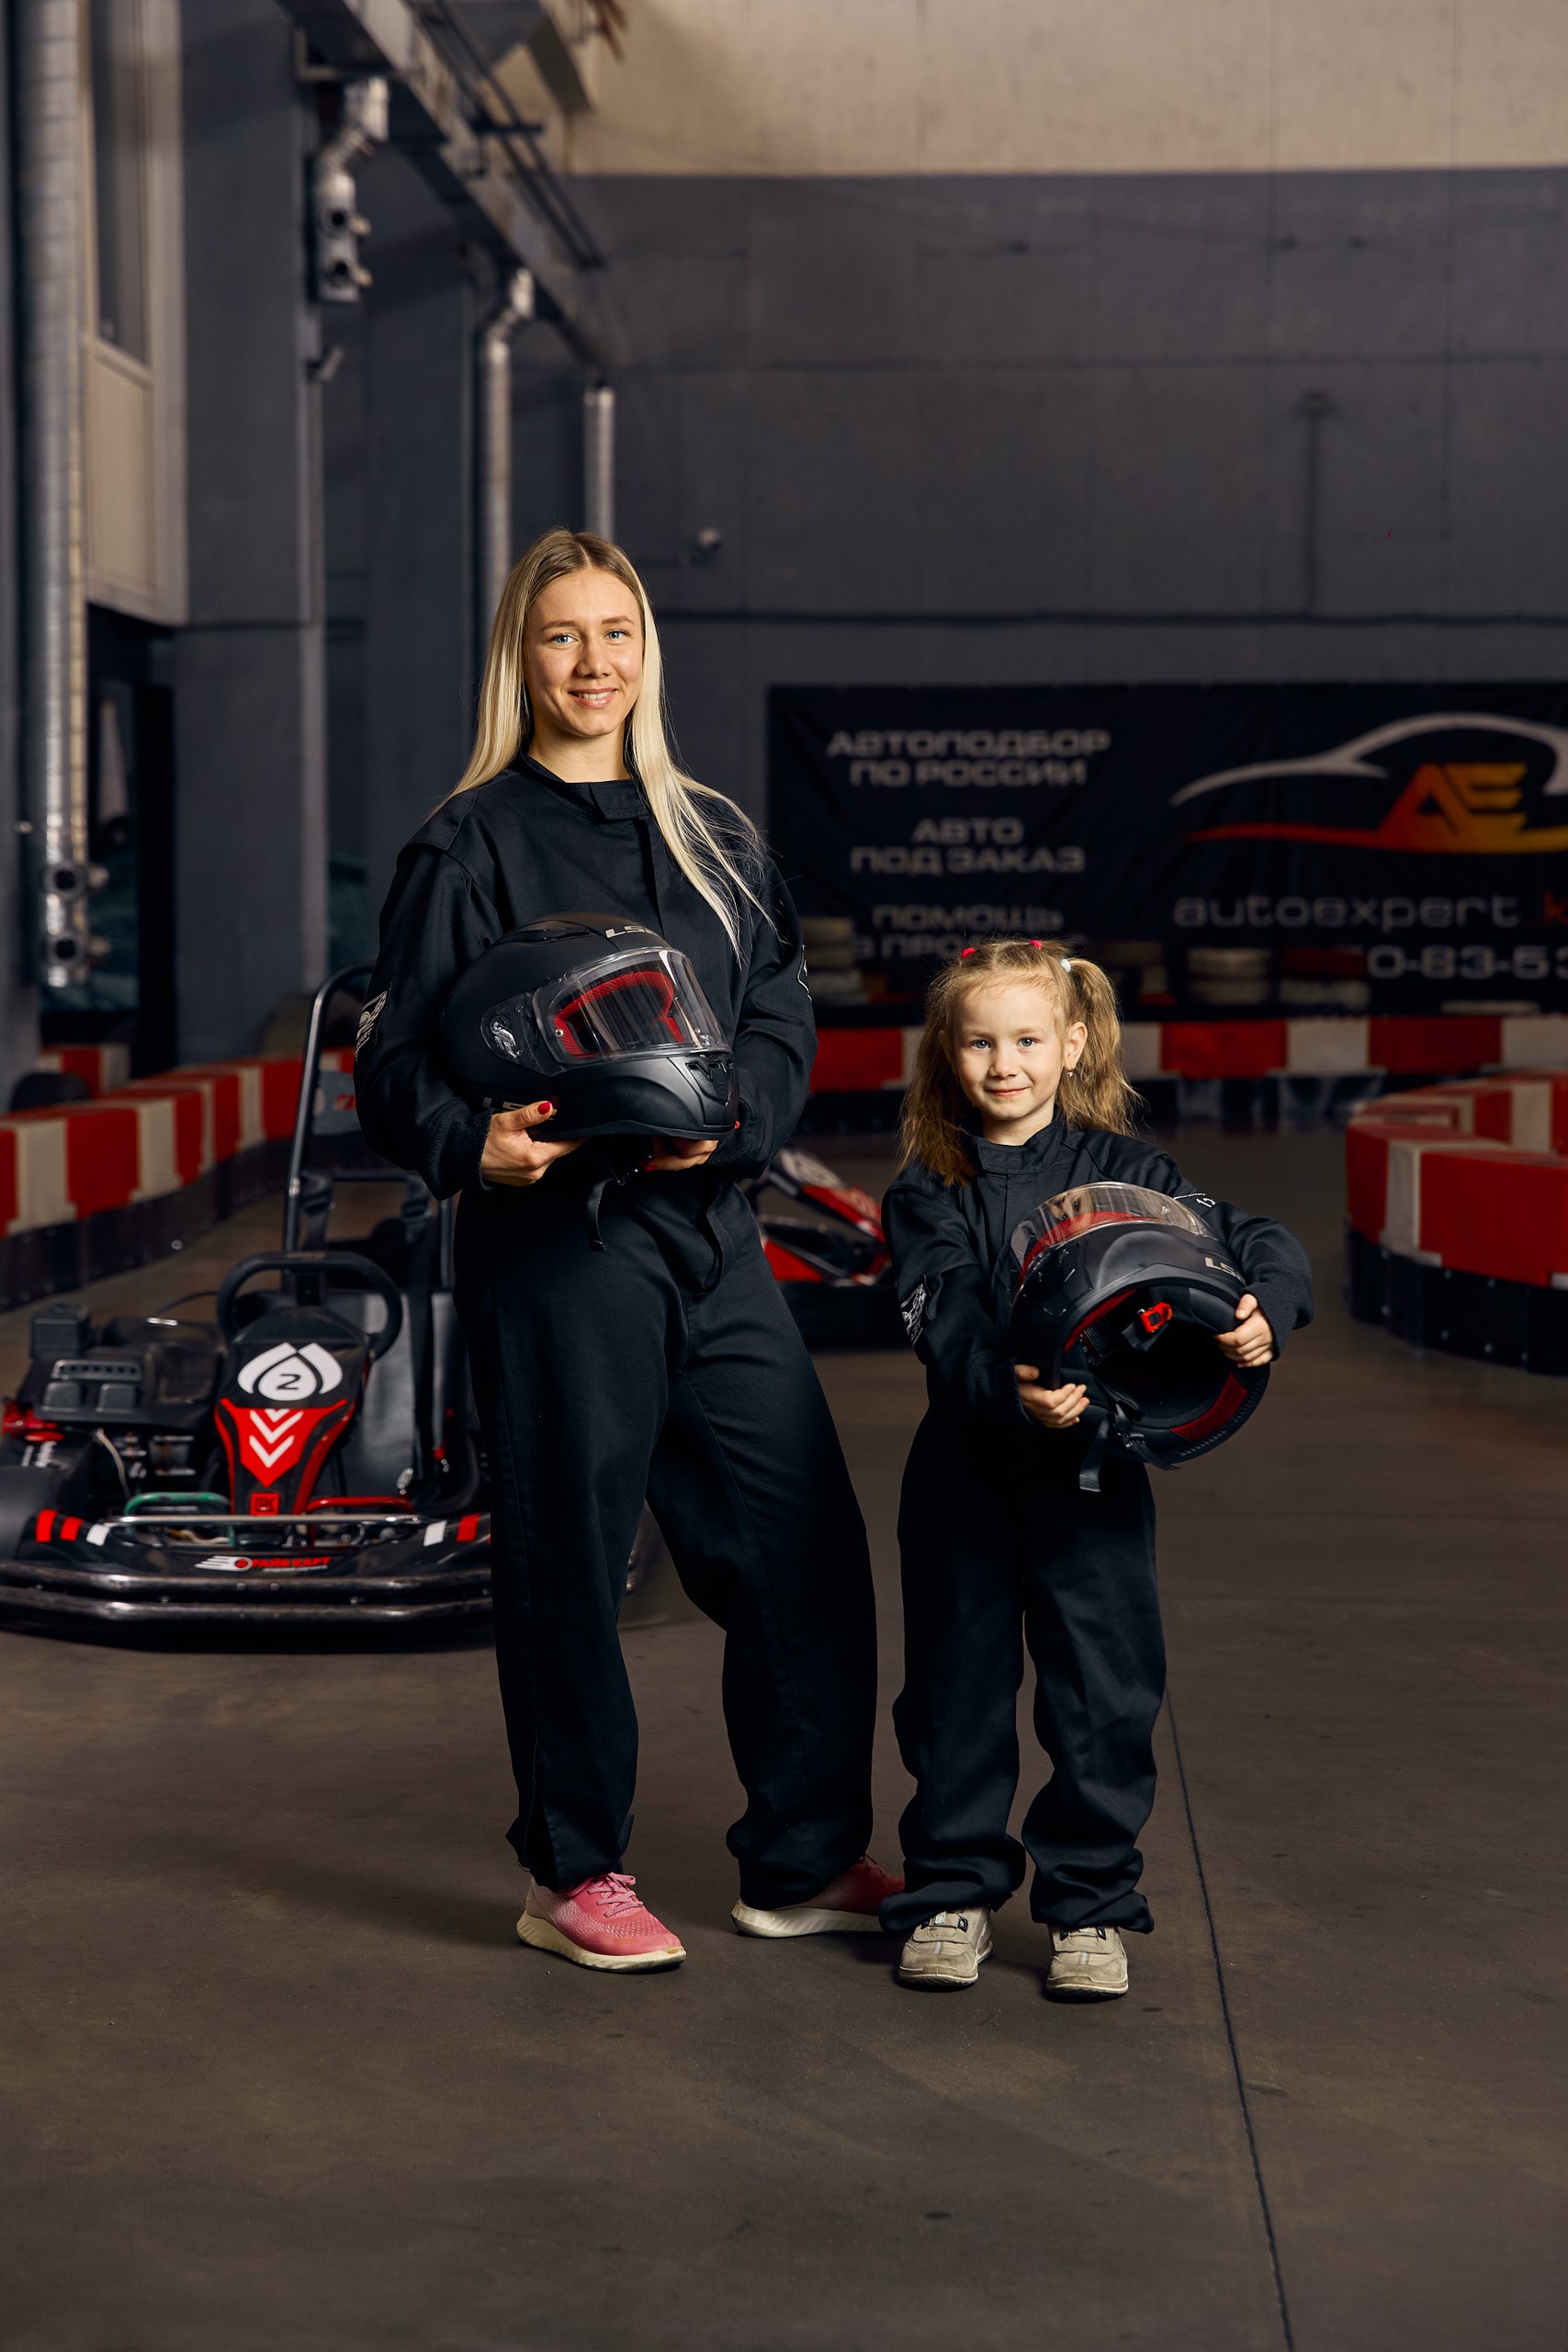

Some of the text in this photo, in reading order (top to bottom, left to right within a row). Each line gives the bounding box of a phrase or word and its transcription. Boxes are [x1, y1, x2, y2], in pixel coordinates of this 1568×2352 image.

[829, 730, 1110, 756] АВТОПОДБОР
[852, 761, 1086, 786] ПО РОССИИ
[913, 819, 1022, 844] АВТО
[852, 847, 1085, 875] ПОД ЗАКАЗ
[874, 906, 1063, 931] ПОМОЩЬ
[1174, 896, 1521, 933] autoexpert
[276, 1373, 301, 1390] 2
